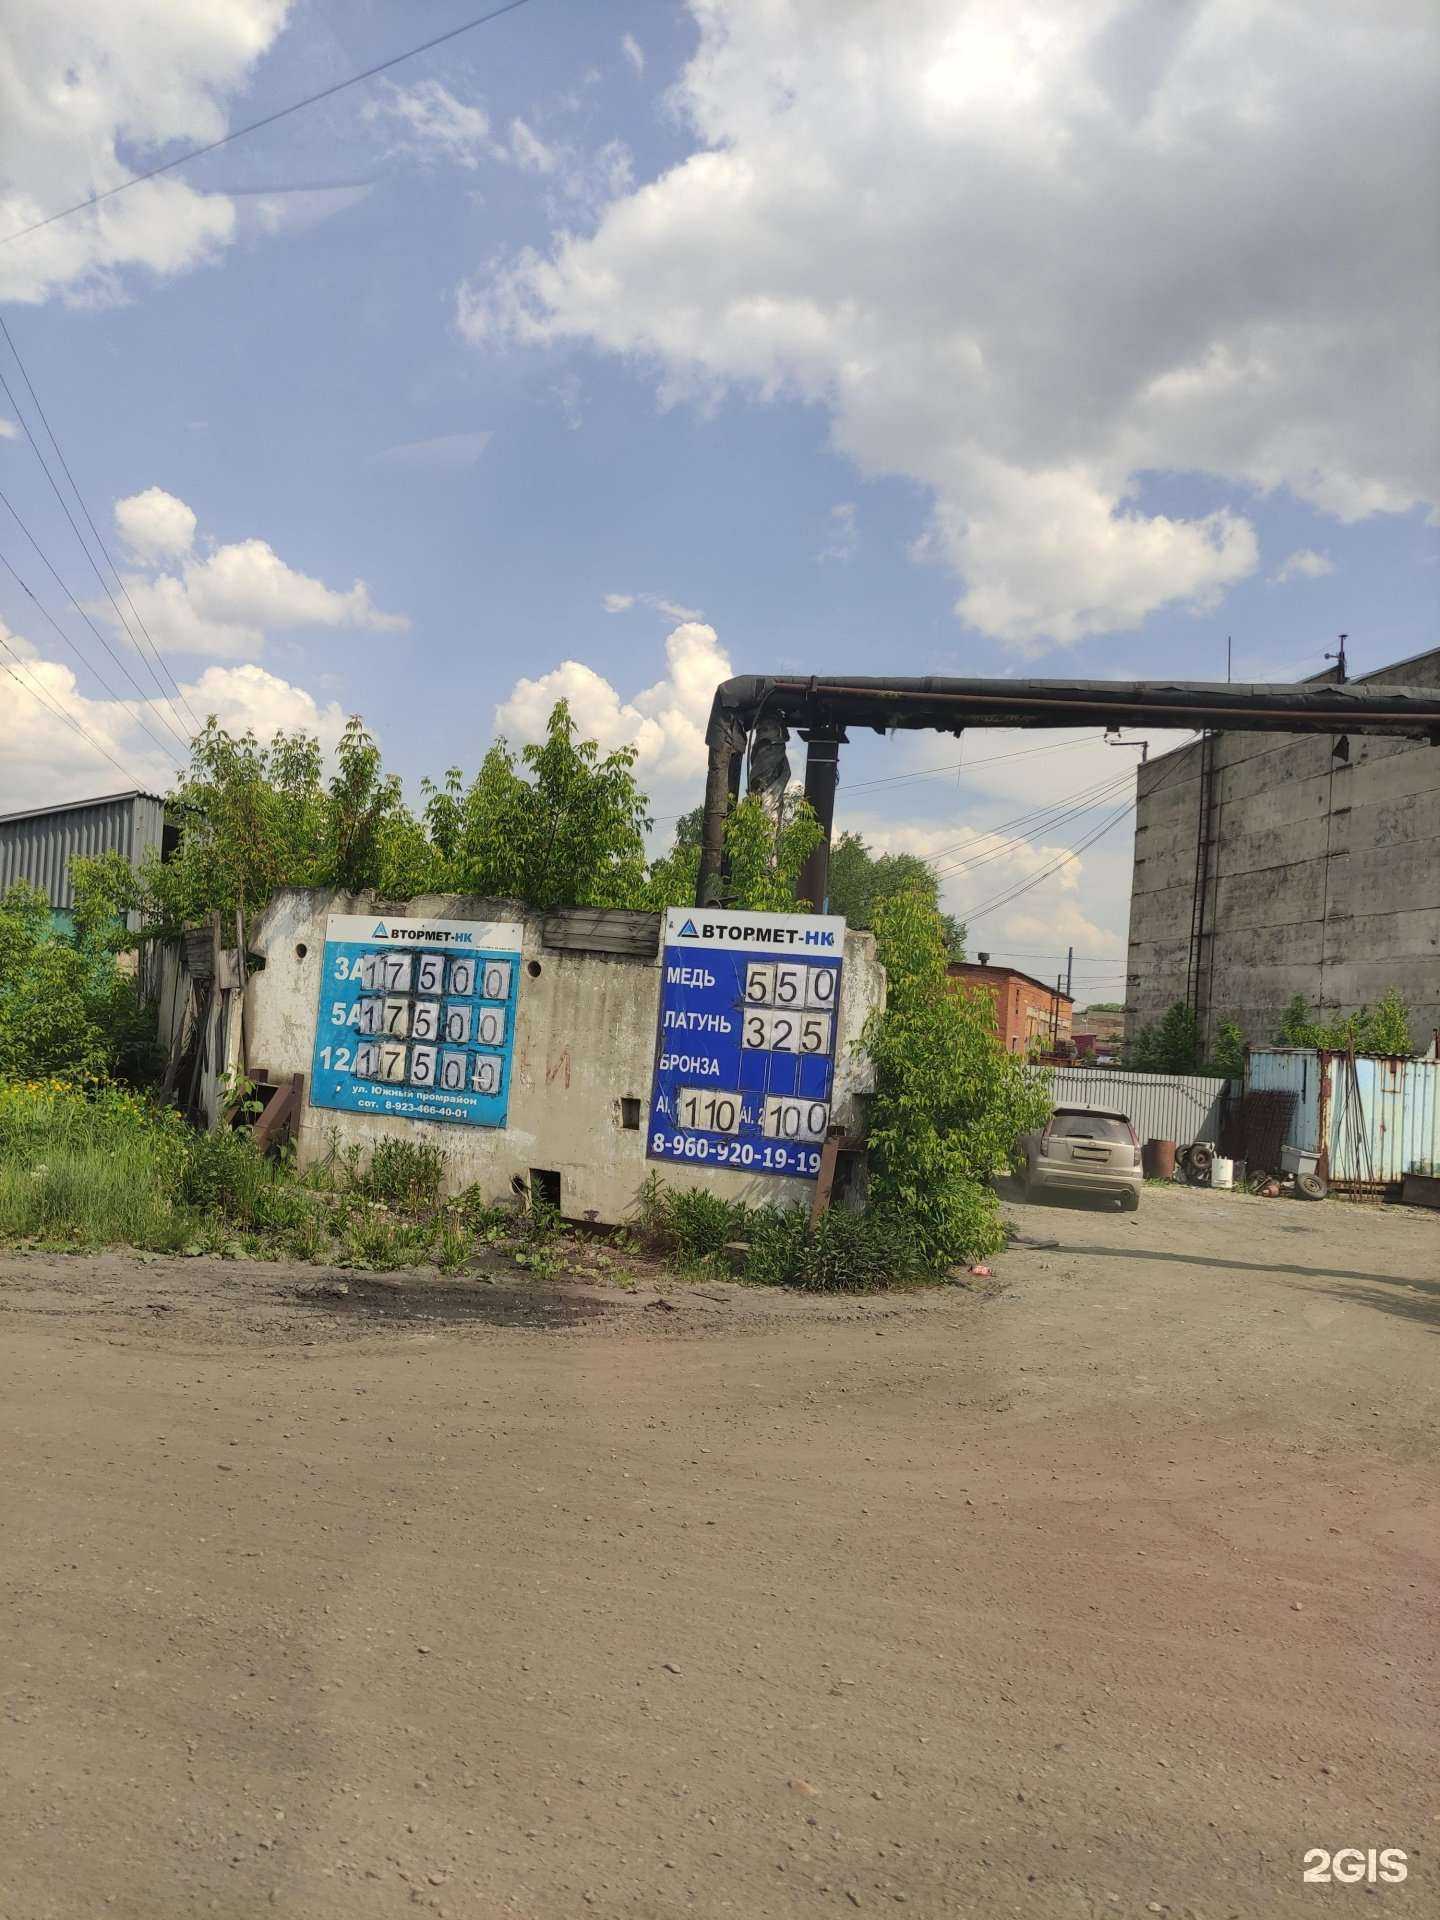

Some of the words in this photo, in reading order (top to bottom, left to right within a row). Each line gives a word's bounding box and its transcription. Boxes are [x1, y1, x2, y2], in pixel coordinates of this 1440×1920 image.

[390, 928, 472, 942] ВТОРМЕТ-НК
[702, 923, 835, 947] ВТОРМЕТ-НК
[667, 966, 716, 988] МЕДЬ
[747, 969, 834, 1002] 550
[663, 1010, 732, 1034] ЛАТУНЬ
[746, 1017, 822, 1051] 325
[660, 1053, 720, 1076] БРОНЗА
[385, 1101, 468, 1118] 8-923-466-40-01
[416, 1092, 477, 1106] промрайон
[685, 1097, 735, 1132] 110
[770, 1103, 827, 1138] 100
[653, 1133, 821, 1173] 8-960-920-19-19
